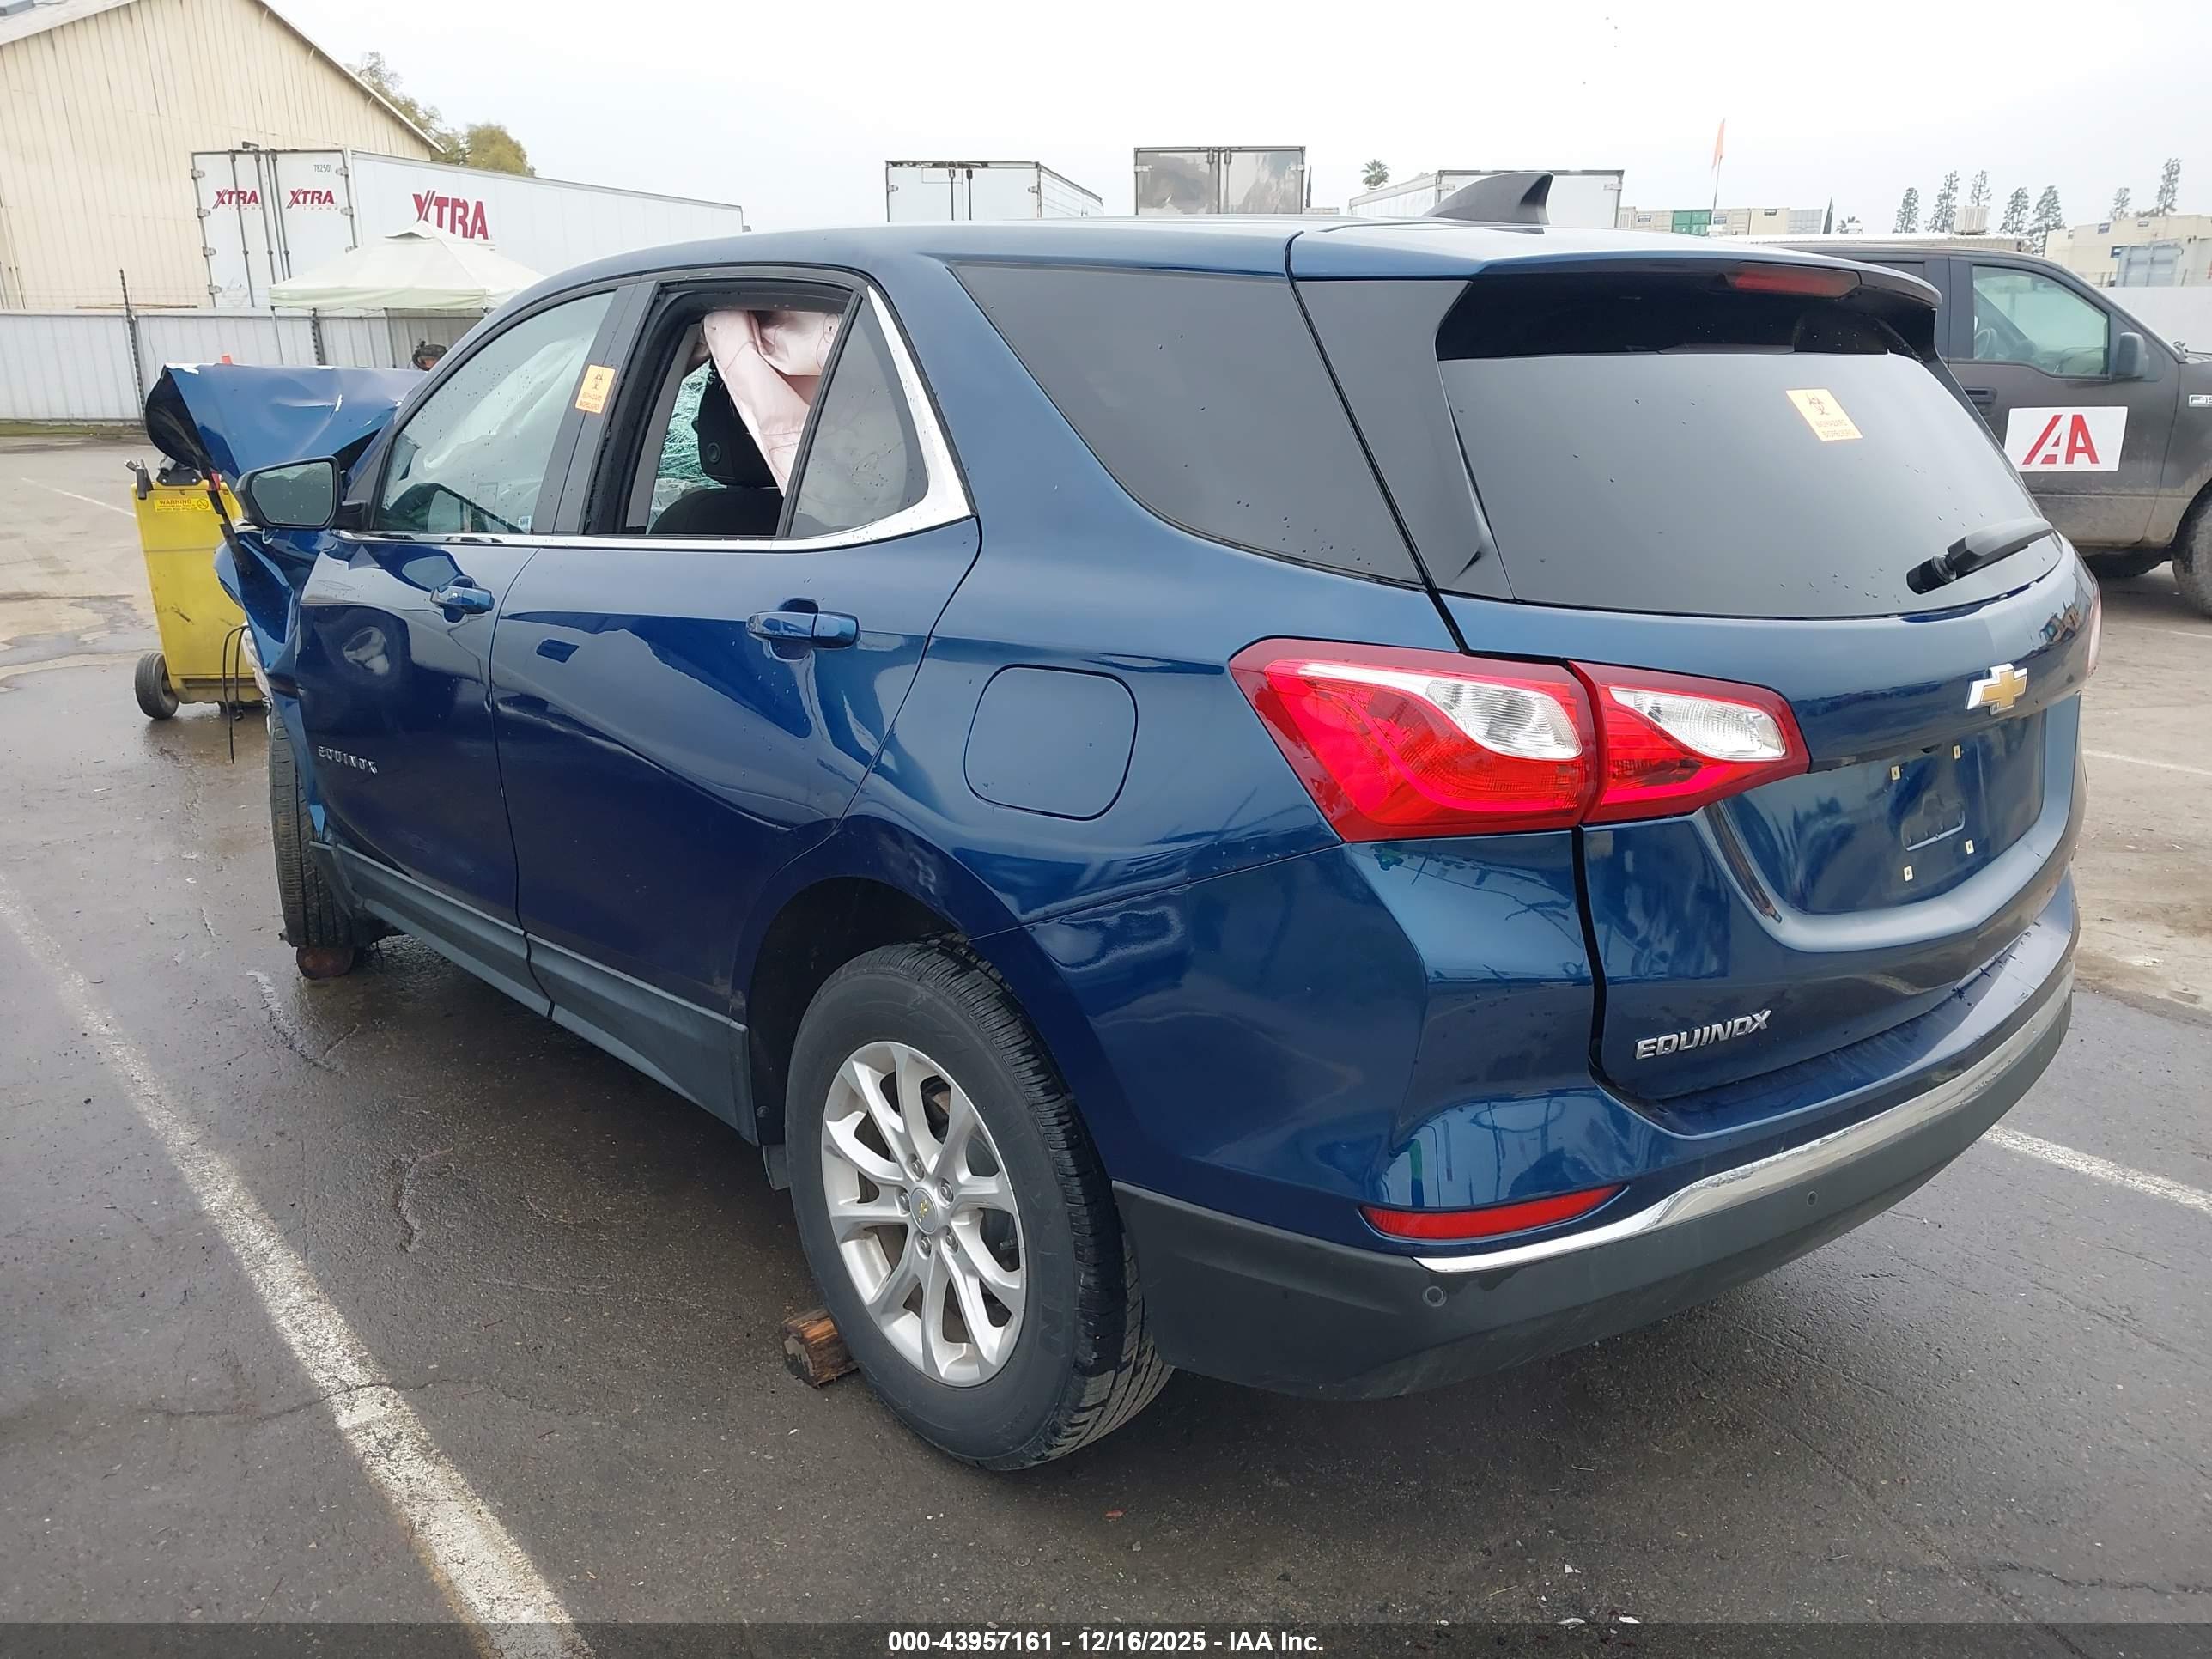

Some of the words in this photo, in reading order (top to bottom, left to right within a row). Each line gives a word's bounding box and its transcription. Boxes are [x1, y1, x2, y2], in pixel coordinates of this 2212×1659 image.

[213, 189, 260, 209] XTRA
[286, 188, 335, 209] XTRA
[412, 189, 489, 240] XTRA
[318, 745, 378, 775] EQUINOX
[1635, 1008, 1772, 1060] EQUINOX
